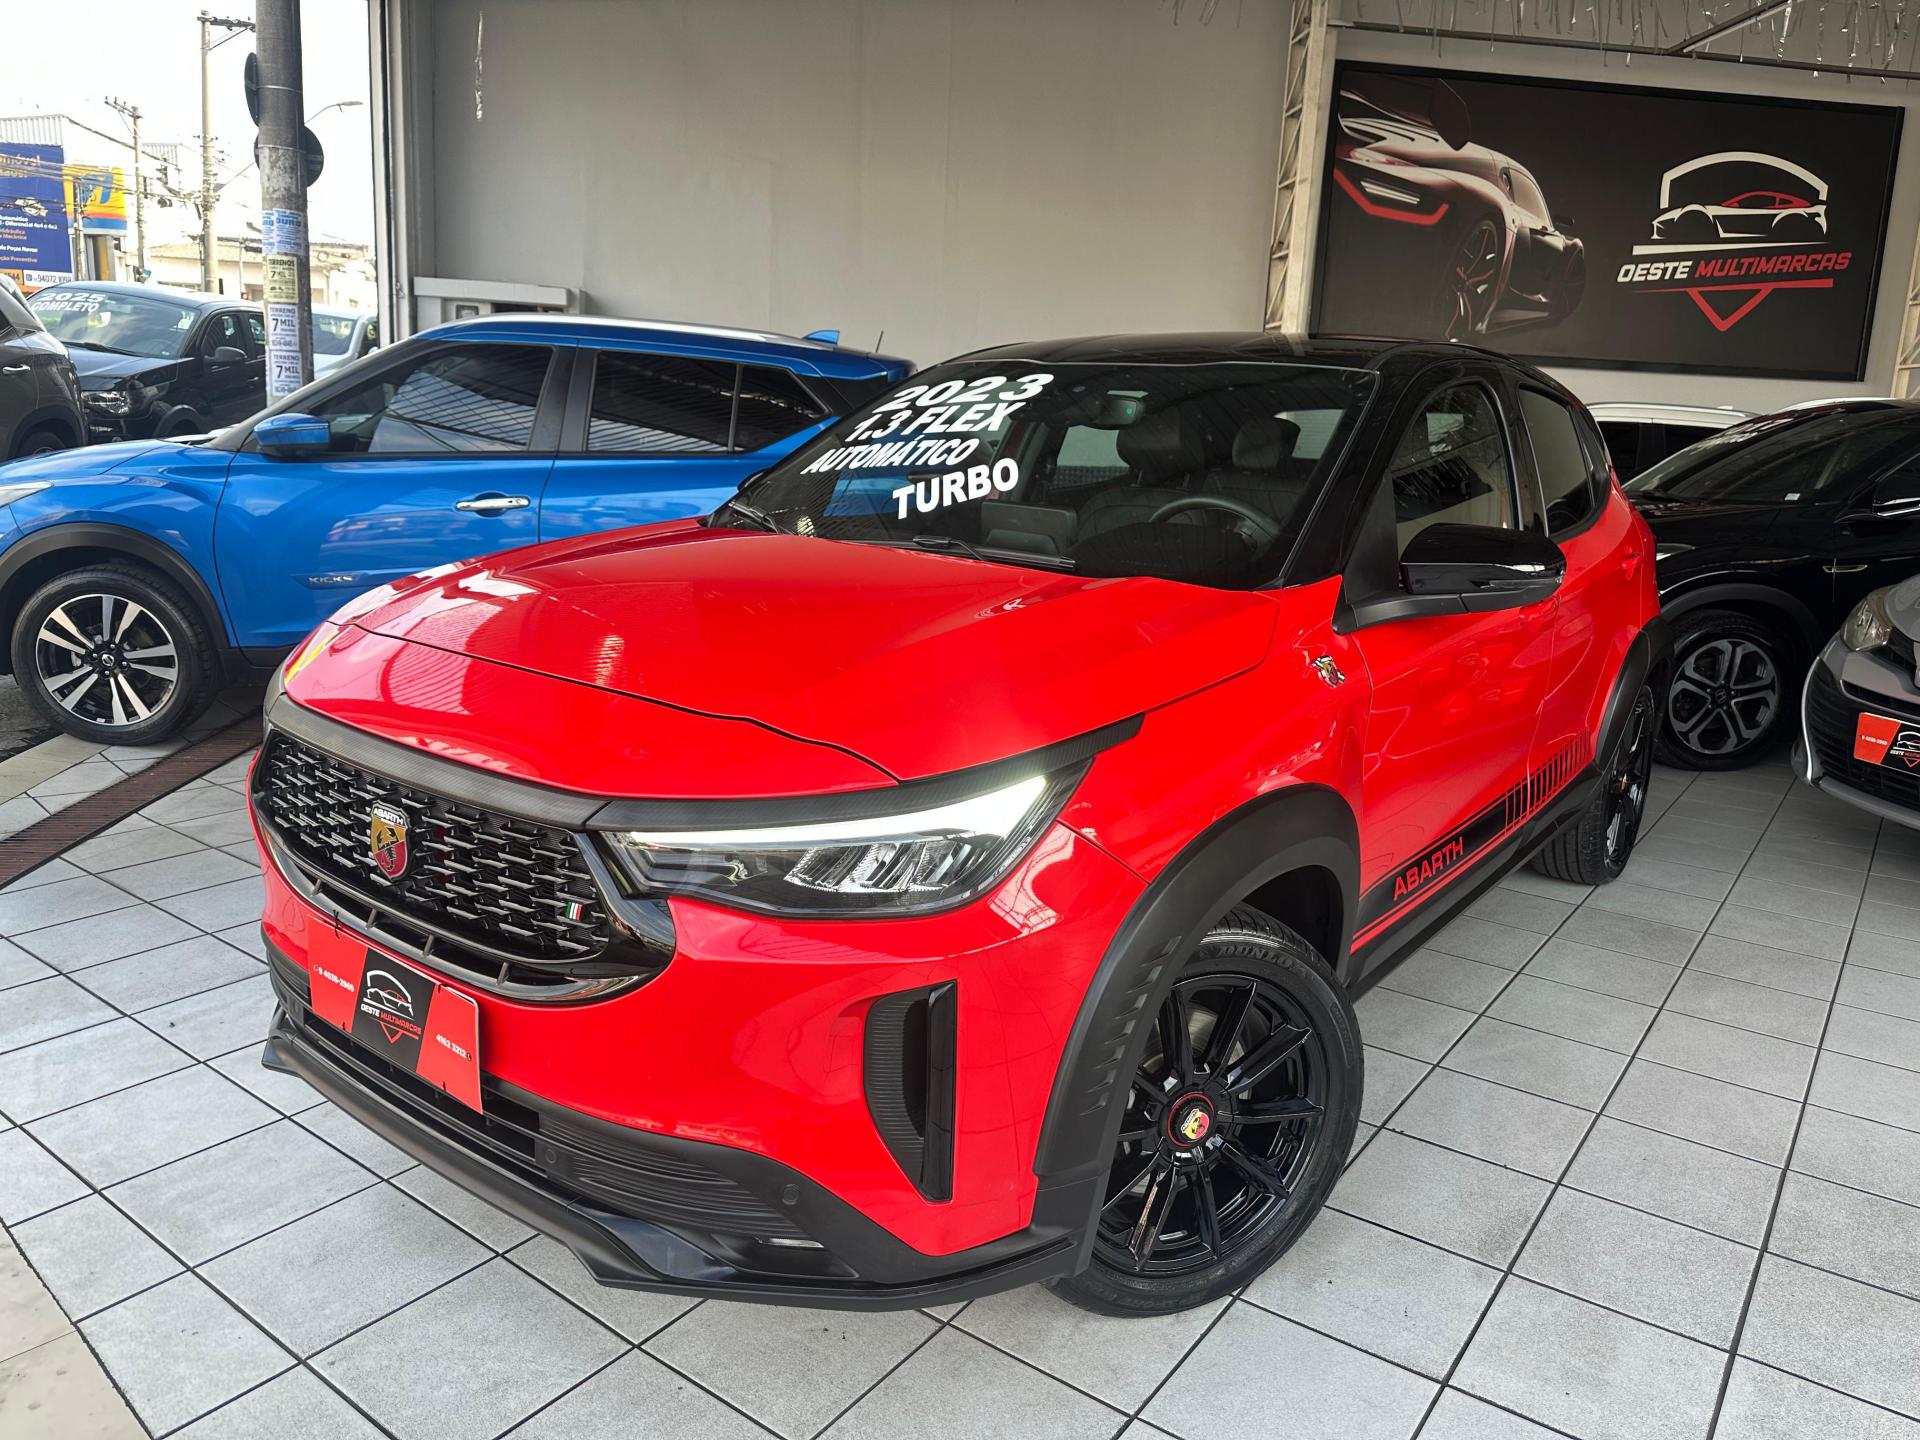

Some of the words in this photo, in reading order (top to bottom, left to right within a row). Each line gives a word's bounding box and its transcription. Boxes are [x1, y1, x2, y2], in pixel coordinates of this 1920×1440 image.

[1617, 261, 1693, 283] OESTE
[1694, 252, 1853, 278] MULTIMARCAS
[30, 301, 101, 312] COMPLETO
[37, 292, 107, 303] 2025
[272, 317, 279, 332] 7
[280, 318, 296, 328] MIL
[276, 365, 283, 379] 7
[284, 365, 300, 374] MIL
[872, 373, 1054, 414] 2023
[845, 409, 912, 442] 1.3
[904, 401, 1026, 436] FLEX
[800, 435, 980, 475] AUTOMÁTICO
[892, 457, 1019, 519] TURBO
[308, 576, 352, 584] KICKS
[374, 808, 403, 825] ABARTH
[1394, 836, 1463, 901] ABARTH
[360, 1003, 380, 1018] OESTE
[380, 1010, 422, 1036] MULTIMARCAS
